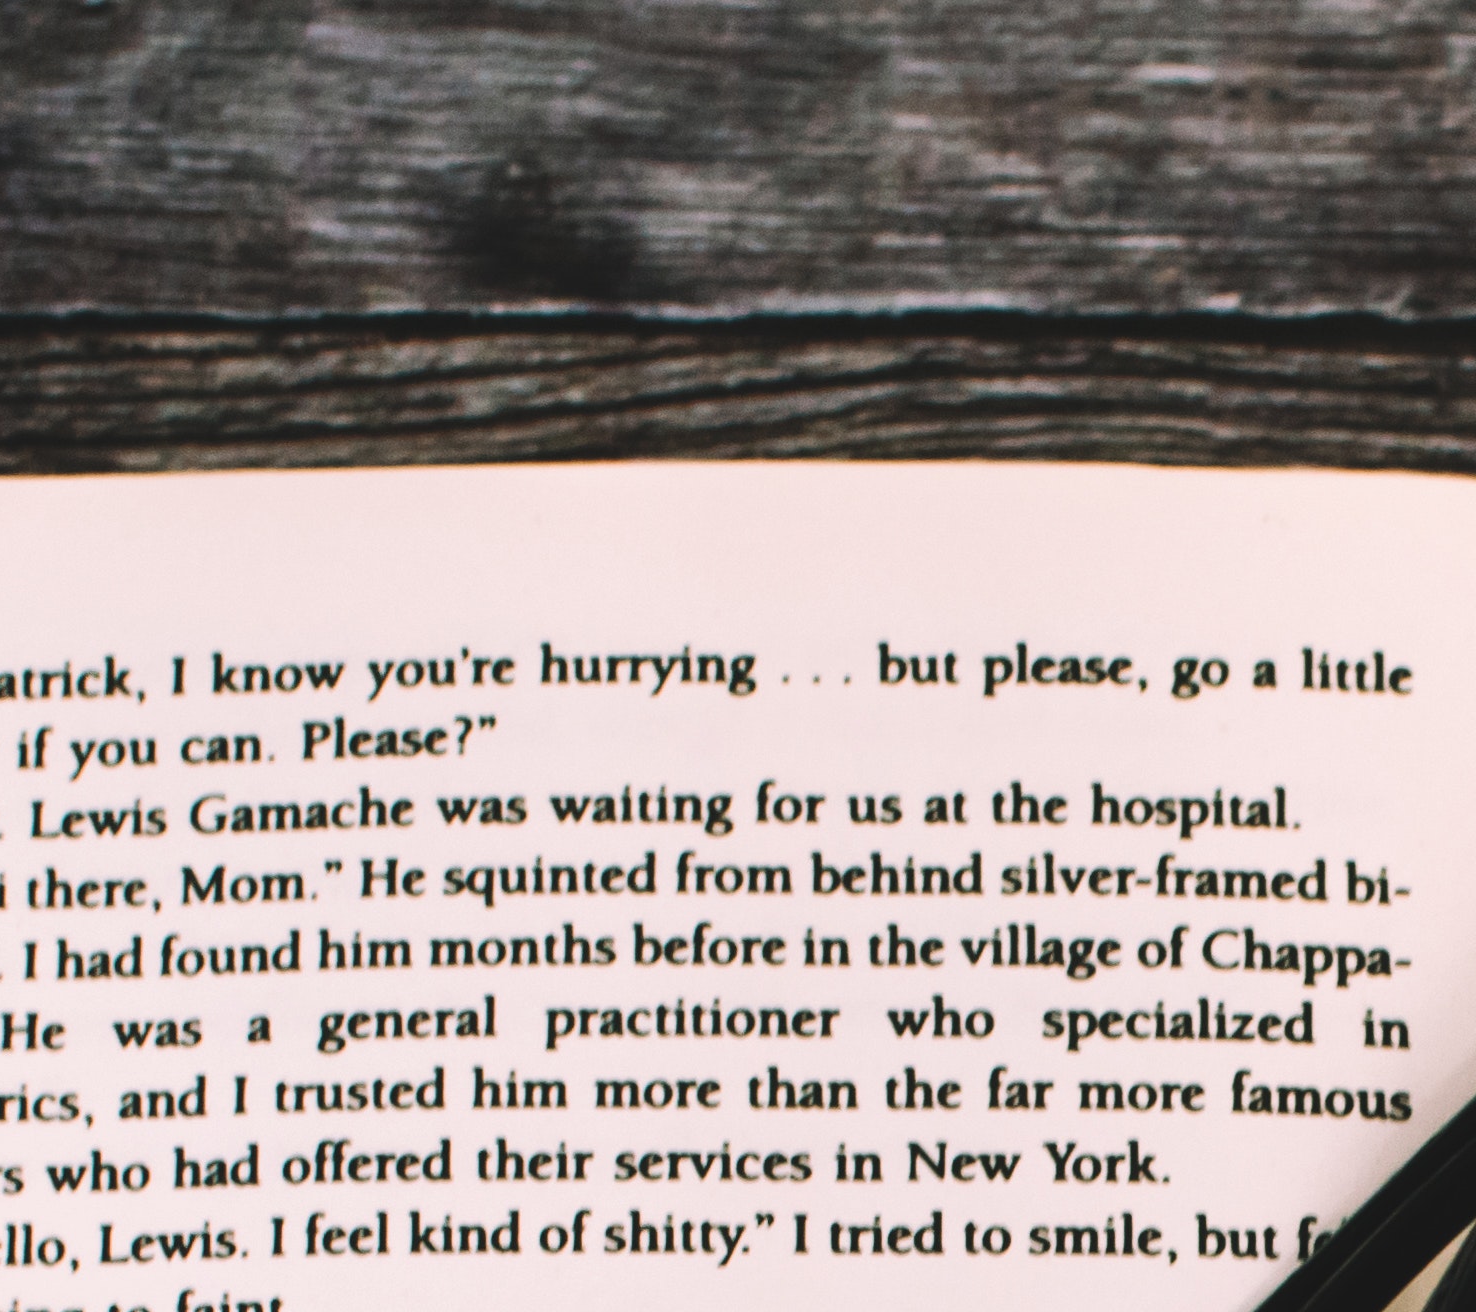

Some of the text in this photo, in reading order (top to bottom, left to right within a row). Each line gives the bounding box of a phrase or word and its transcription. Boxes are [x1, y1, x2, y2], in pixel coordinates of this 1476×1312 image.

[17, 725, 53, 770] if
[70, 738, 157, 782] you
[180, 734, 274, 765] can.
[302, 714, 497, 761] Please?”
[31, 799, 167, 839] Lewis
[189, 785, 414, 835] Gamache
[436, 795, 528, 825] was
[549, 785, 734, 837] waiting
[756, 779, 826, 824] for
[847, 794, 903, 825] us
[924, 791, 967, 825] at
[992, 780, 1068, 826] the
[1091, 781, 1301, 840] hospital.
[24, 941, 37, 980] I
[57, 934, 143, 980] had
[160, 928, 300, 977] found
[319, 928, 412, 970] him
[430, 922, 617, 967] months
[633, 921, 786, 966] before
[803, 927, 850, 967] in
[869, 923, 944, 968] the
[960, 922, 1121, 981] village
[1137, 925, 1189, 969] of
[1202, 927, 1411, 988] Chappa-
[46, 1149, 150, 1193] who
[174, 1142, 260, 1189] had
[282, 1138, 452, 1185] offered
[477, 1137, 594, 1182] their
[614, 1141, 812, 1183] services
[835, 1142, 883, 1182] in
[907, 1141, 1021, 1183] New
[1043, 1139, 1170, 1184] York.
